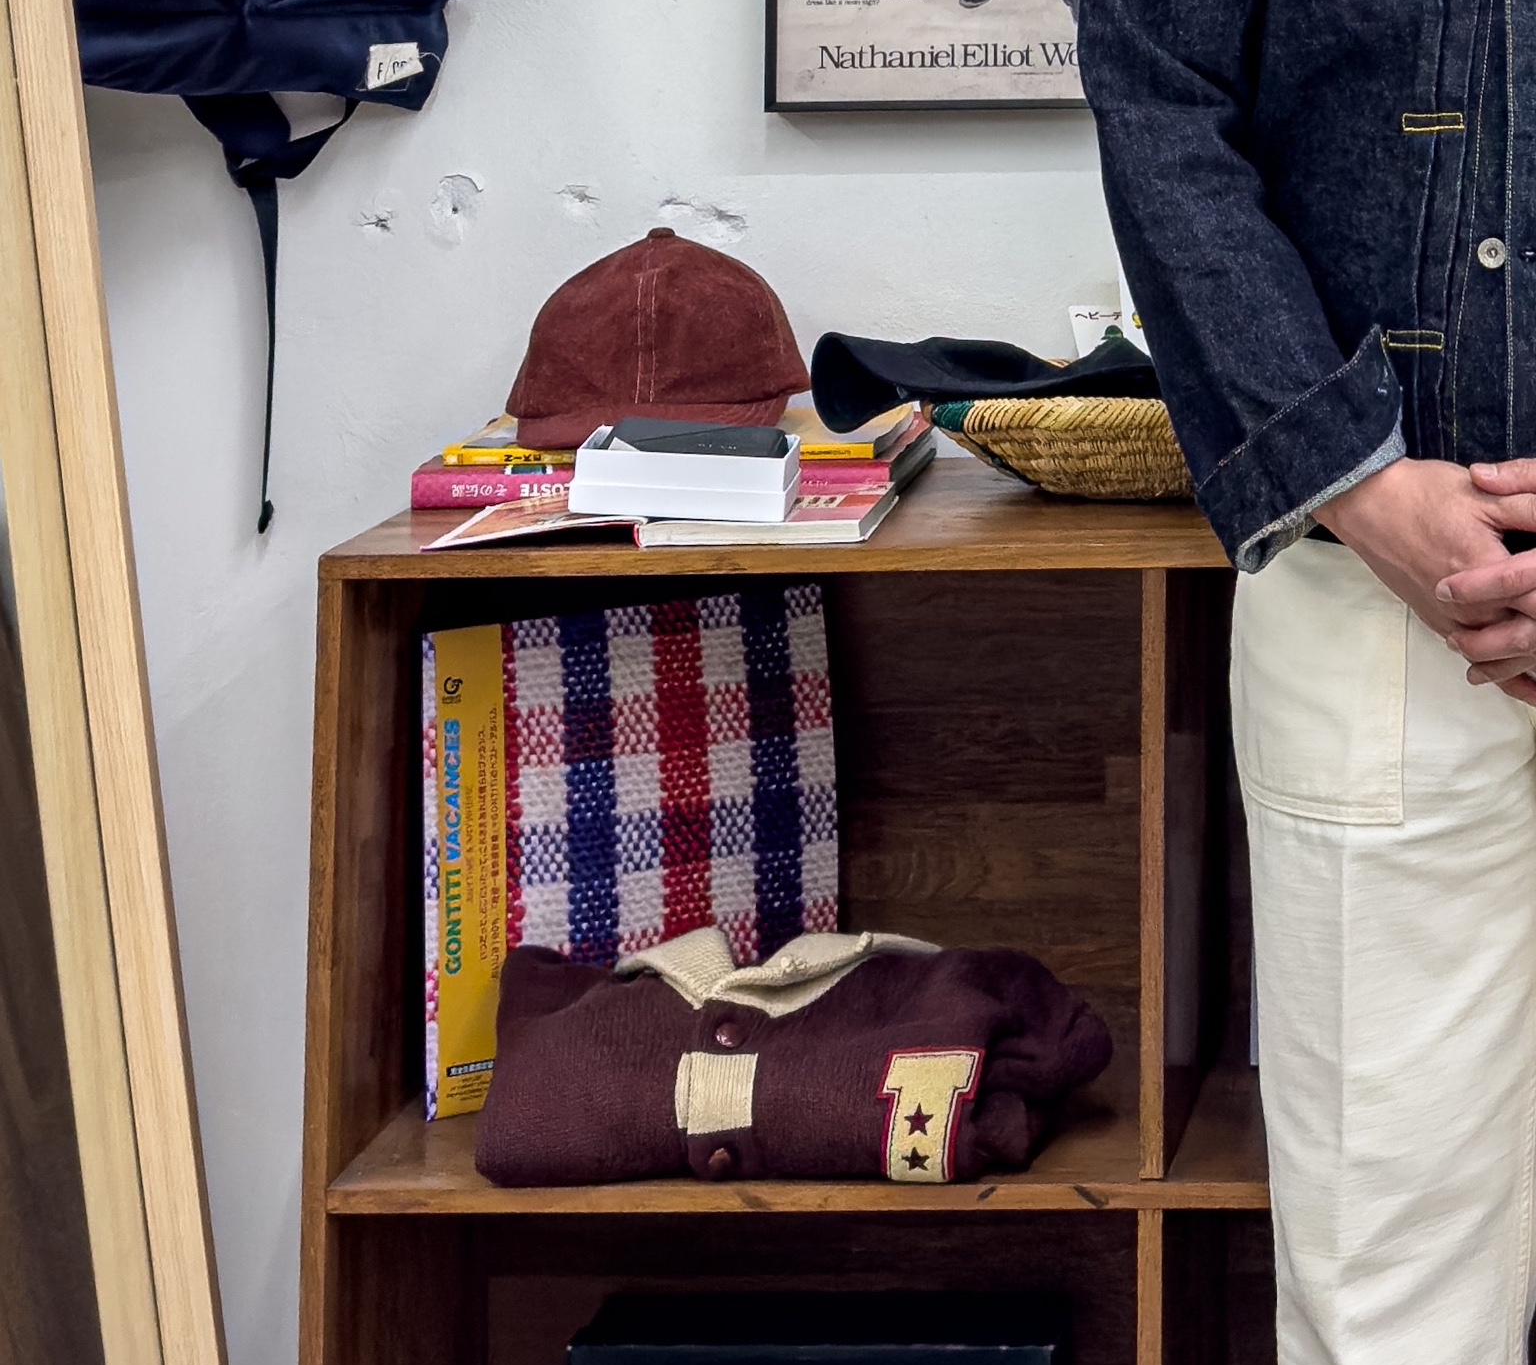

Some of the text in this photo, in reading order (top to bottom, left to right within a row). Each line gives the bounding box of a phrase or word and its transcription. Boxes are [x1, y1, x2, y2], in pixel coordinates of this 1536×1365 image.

[817, 43, 956, 70] Nathaniel
[960, 43, 1034, 68] Elliot
[451, 483, 508, 498] その伝説
[443, 718, 463, 862] VACANCES
[443, 868, 463, 976] GONTITI
